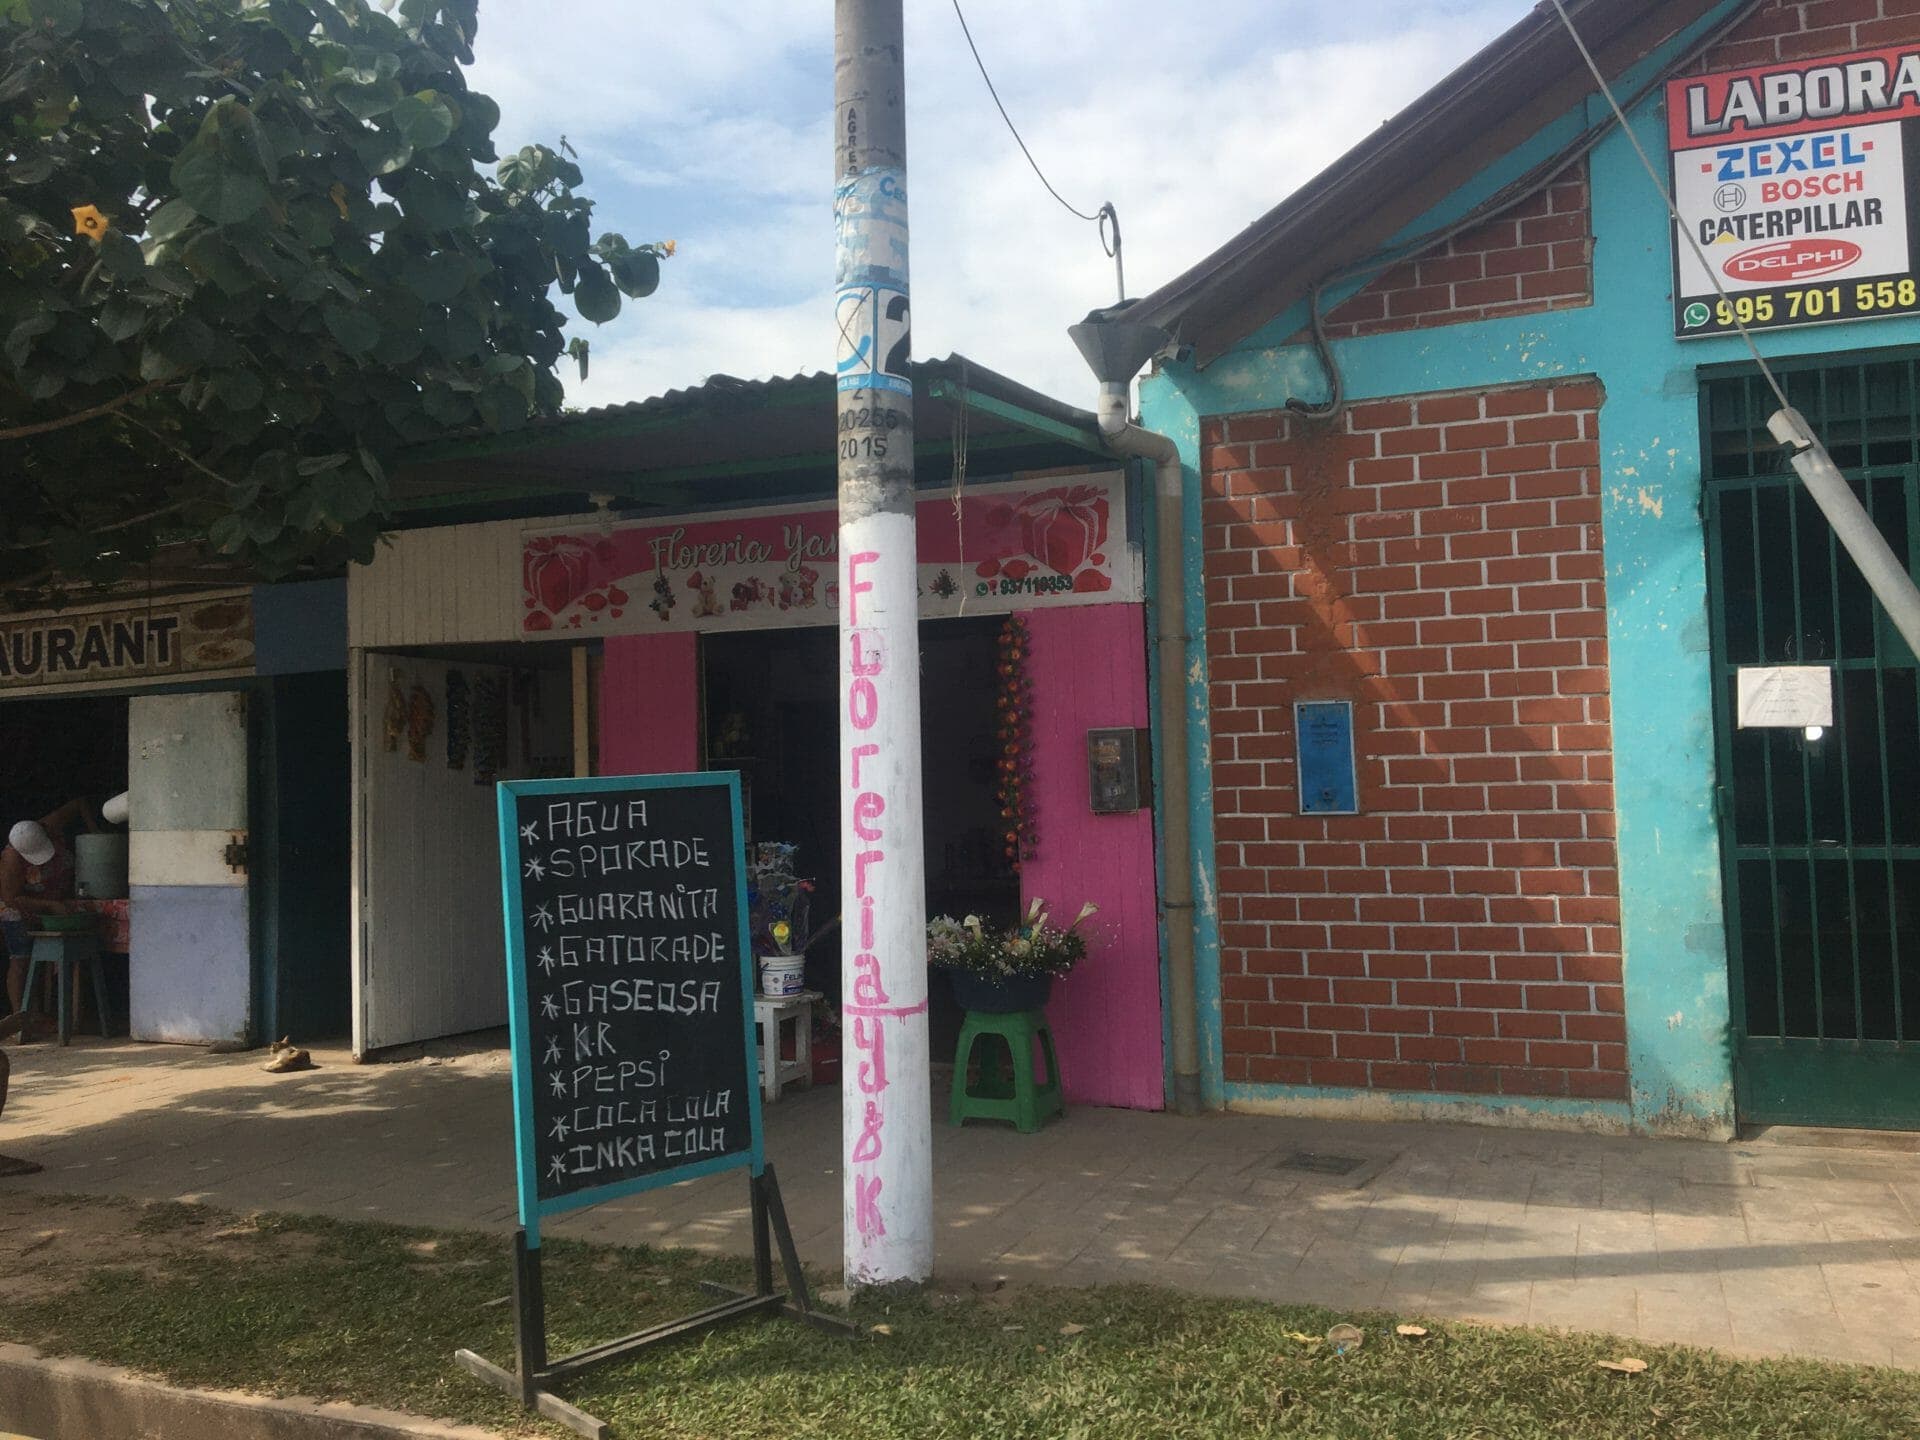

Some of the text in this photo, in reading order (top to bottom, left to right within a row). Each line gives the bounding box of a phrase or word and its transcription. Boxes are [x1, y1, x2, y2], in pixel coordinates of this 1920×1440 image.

[1717, 133, 1866, 182] ZEXEL
[1761, 170, 1863, 203] BOSCH
[1700, 197, 1883, 246] CATERPILLAR
[1738, 249, 1844, 272] DELPHI
[1715, 279, 1917, 326] 995 701 558
[840, 436, 888, 459] 2015
[650, 527, 773, 578] Floreria
[548, 799, 648, 841] AGUA
[550, 837, 711, 879] SPORADE
[560, 932, 726, 967] GATORADE
[562, 979, 721, 1016] GASEOSA
[574, 1099, 657, 1132] COCA
[569, 1126, 725, 1174] INKA COLA
